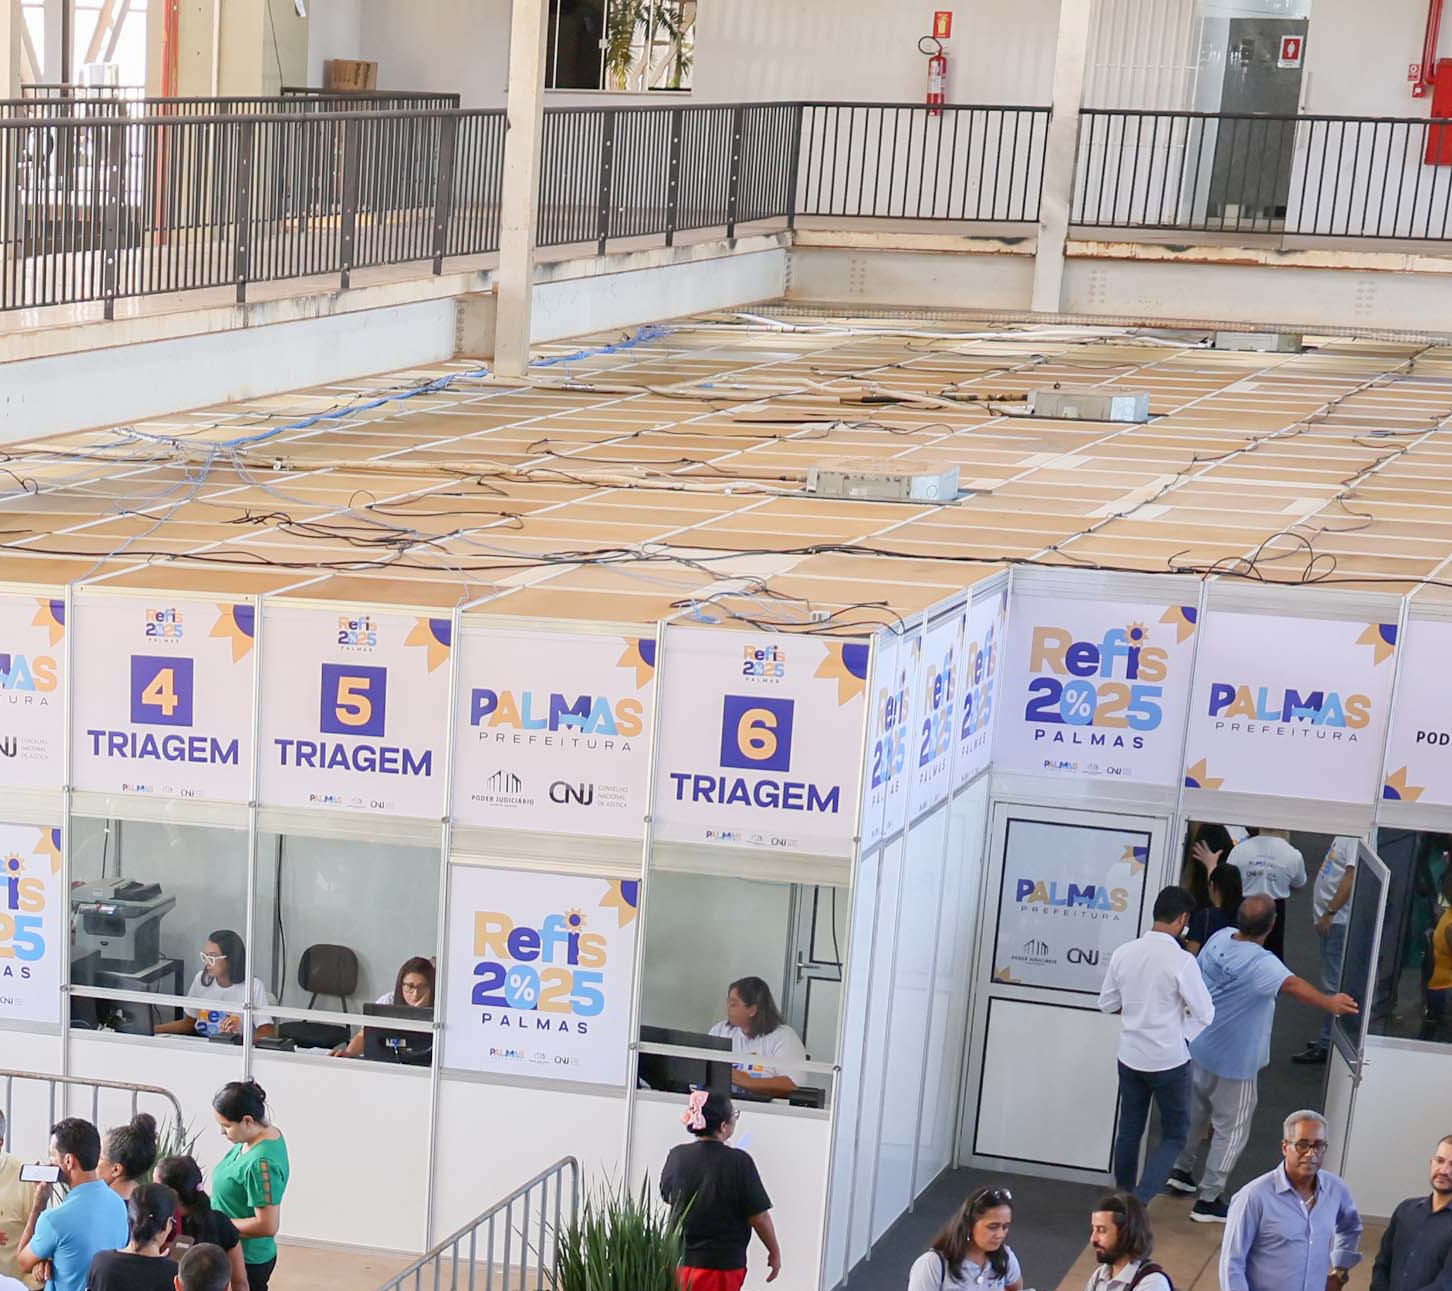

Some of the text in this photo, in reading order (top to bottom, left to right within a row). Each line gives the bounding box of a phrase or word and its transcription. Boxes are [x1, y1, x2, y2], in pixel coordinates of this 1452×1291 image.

[146, 608, 184, 623] Refis
[743, 645, 786, 662] Refis
[743, 661, 784, 677] 2025
[1029, 620, 1168, 682] Refis
[142, 668, 178, 716] 4
[335, 676, 372, 726] 5
[1025, 677, 1164, 731] 2025
[1208, 682, 1372, 729] PALMAS
[471, 688, 643, 737] PALMAS
[87, 729, 239, 765] TRIAGEM
[480, 732, 631, 751] PREFEITURA
[737, 708, 778, 760] 6
[1034, 729, 1144, 749] PALMAS
[1215, 722, 1358, 742] PREFEITURA
[274, 738, 432, 776] TRIAGEM
[549, 781, 593, 806] CNJ
[670, 773, 840, 813] TRIAGEM
[1016, 879, 1128, 912] PALMAS
[1021, 906, 1120, 920] PREFEITURA
[473, 908, 607, 968] Refis
[1067, 948, 1099, 966] CNJ
[472, 962, 605, 1017] 2025
[482, 1013, 588, 1034] PALMAS
